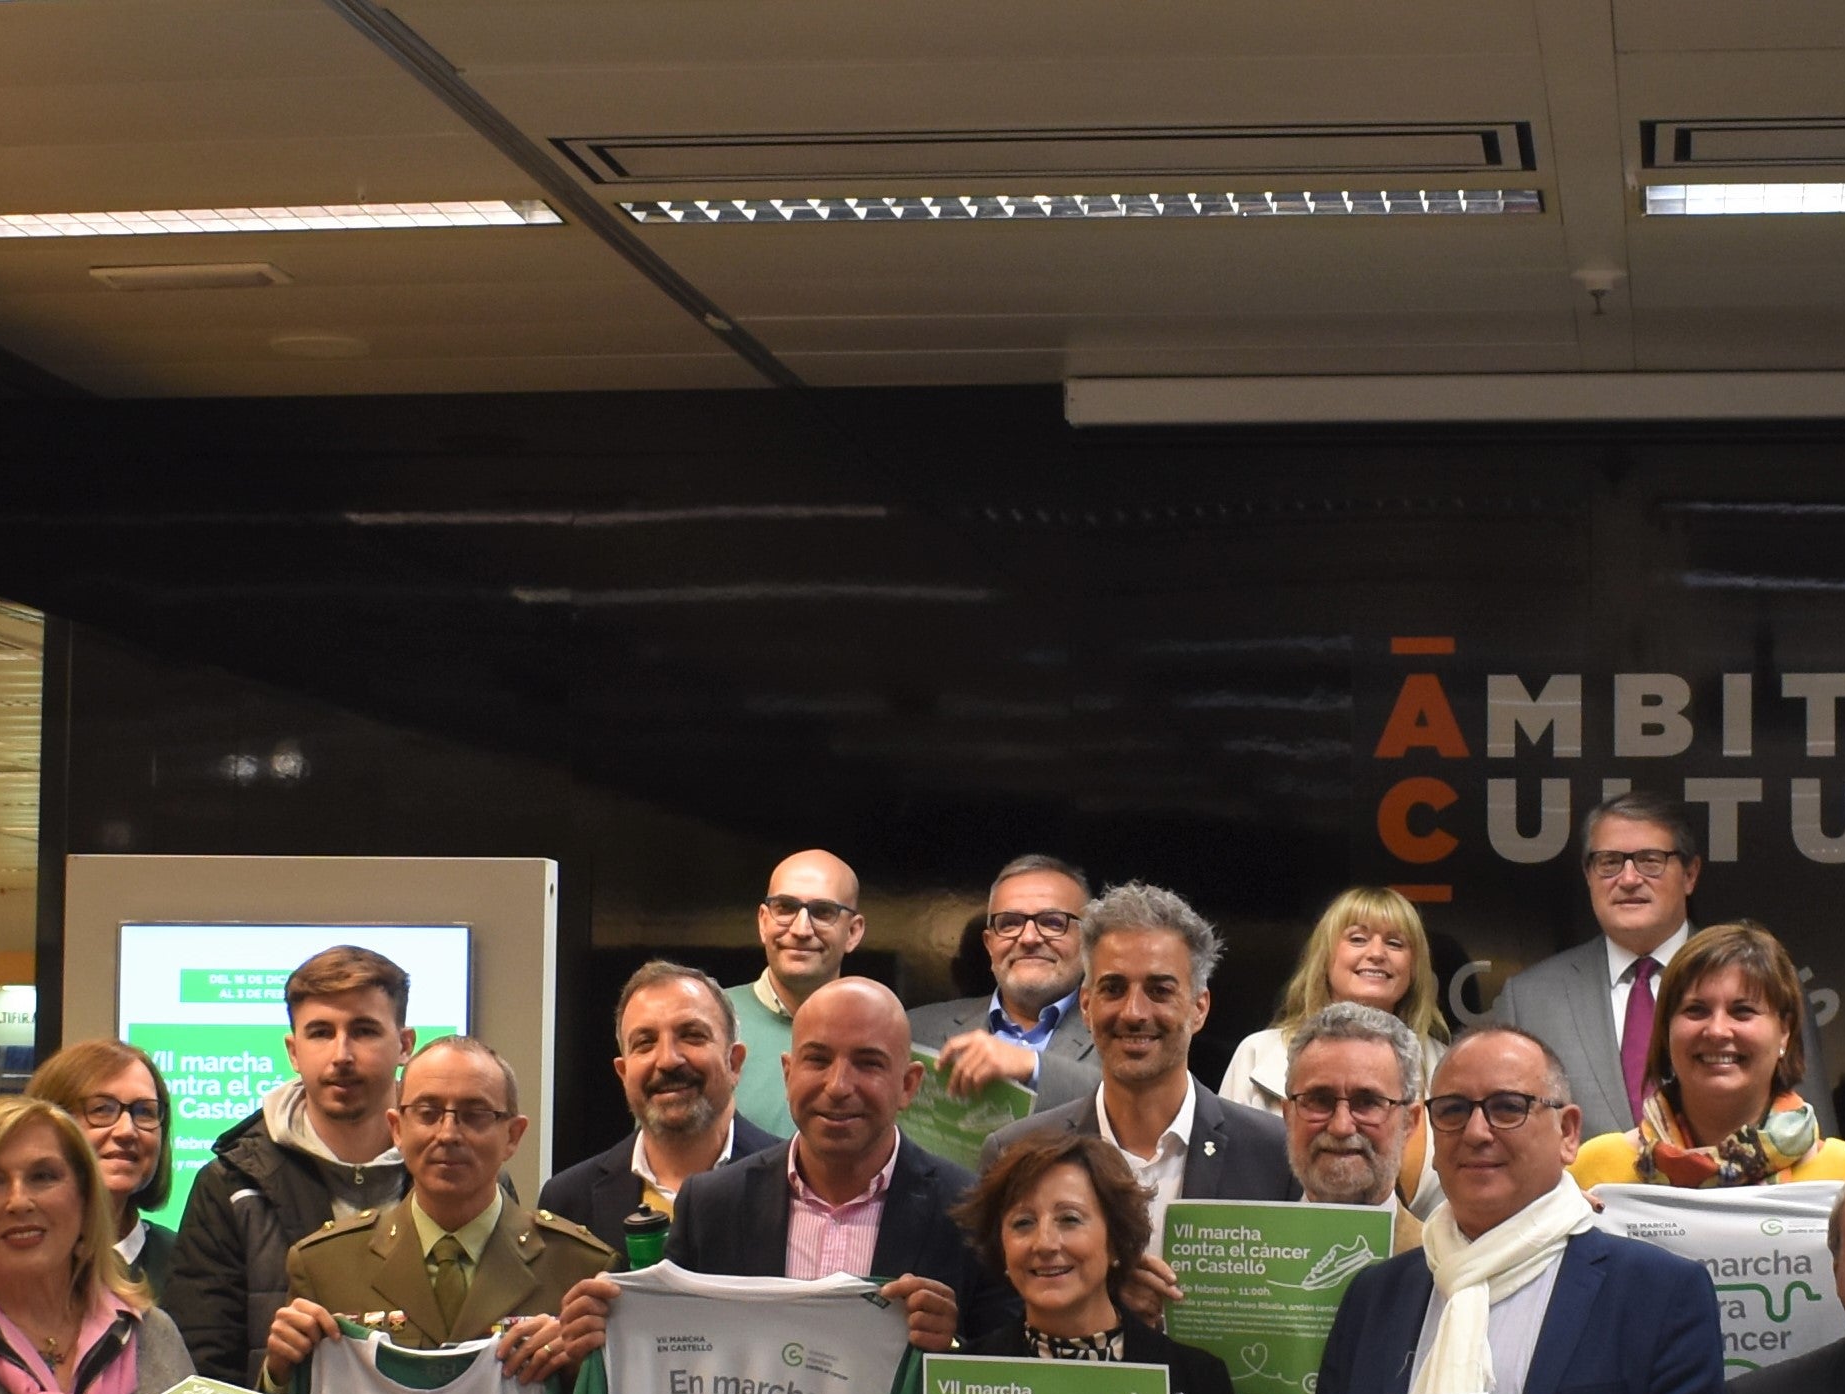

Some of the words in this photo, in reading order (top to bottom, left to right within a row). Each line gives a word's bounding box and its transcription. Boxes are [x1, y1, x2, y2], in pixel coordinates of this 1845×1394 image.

[180, 1051, 273, 1072] marcha
[228, 1075, 249, 1096] el
[1698, 1250, 1812, 1277] marcha
[657, 1344, 669, 1352] EN
[671, 1342, 712, 1352] CASTELLÓ
[669, 1335, 705, 1343] MARCHA
[1724, 1329, 1792, 1350] ncer
